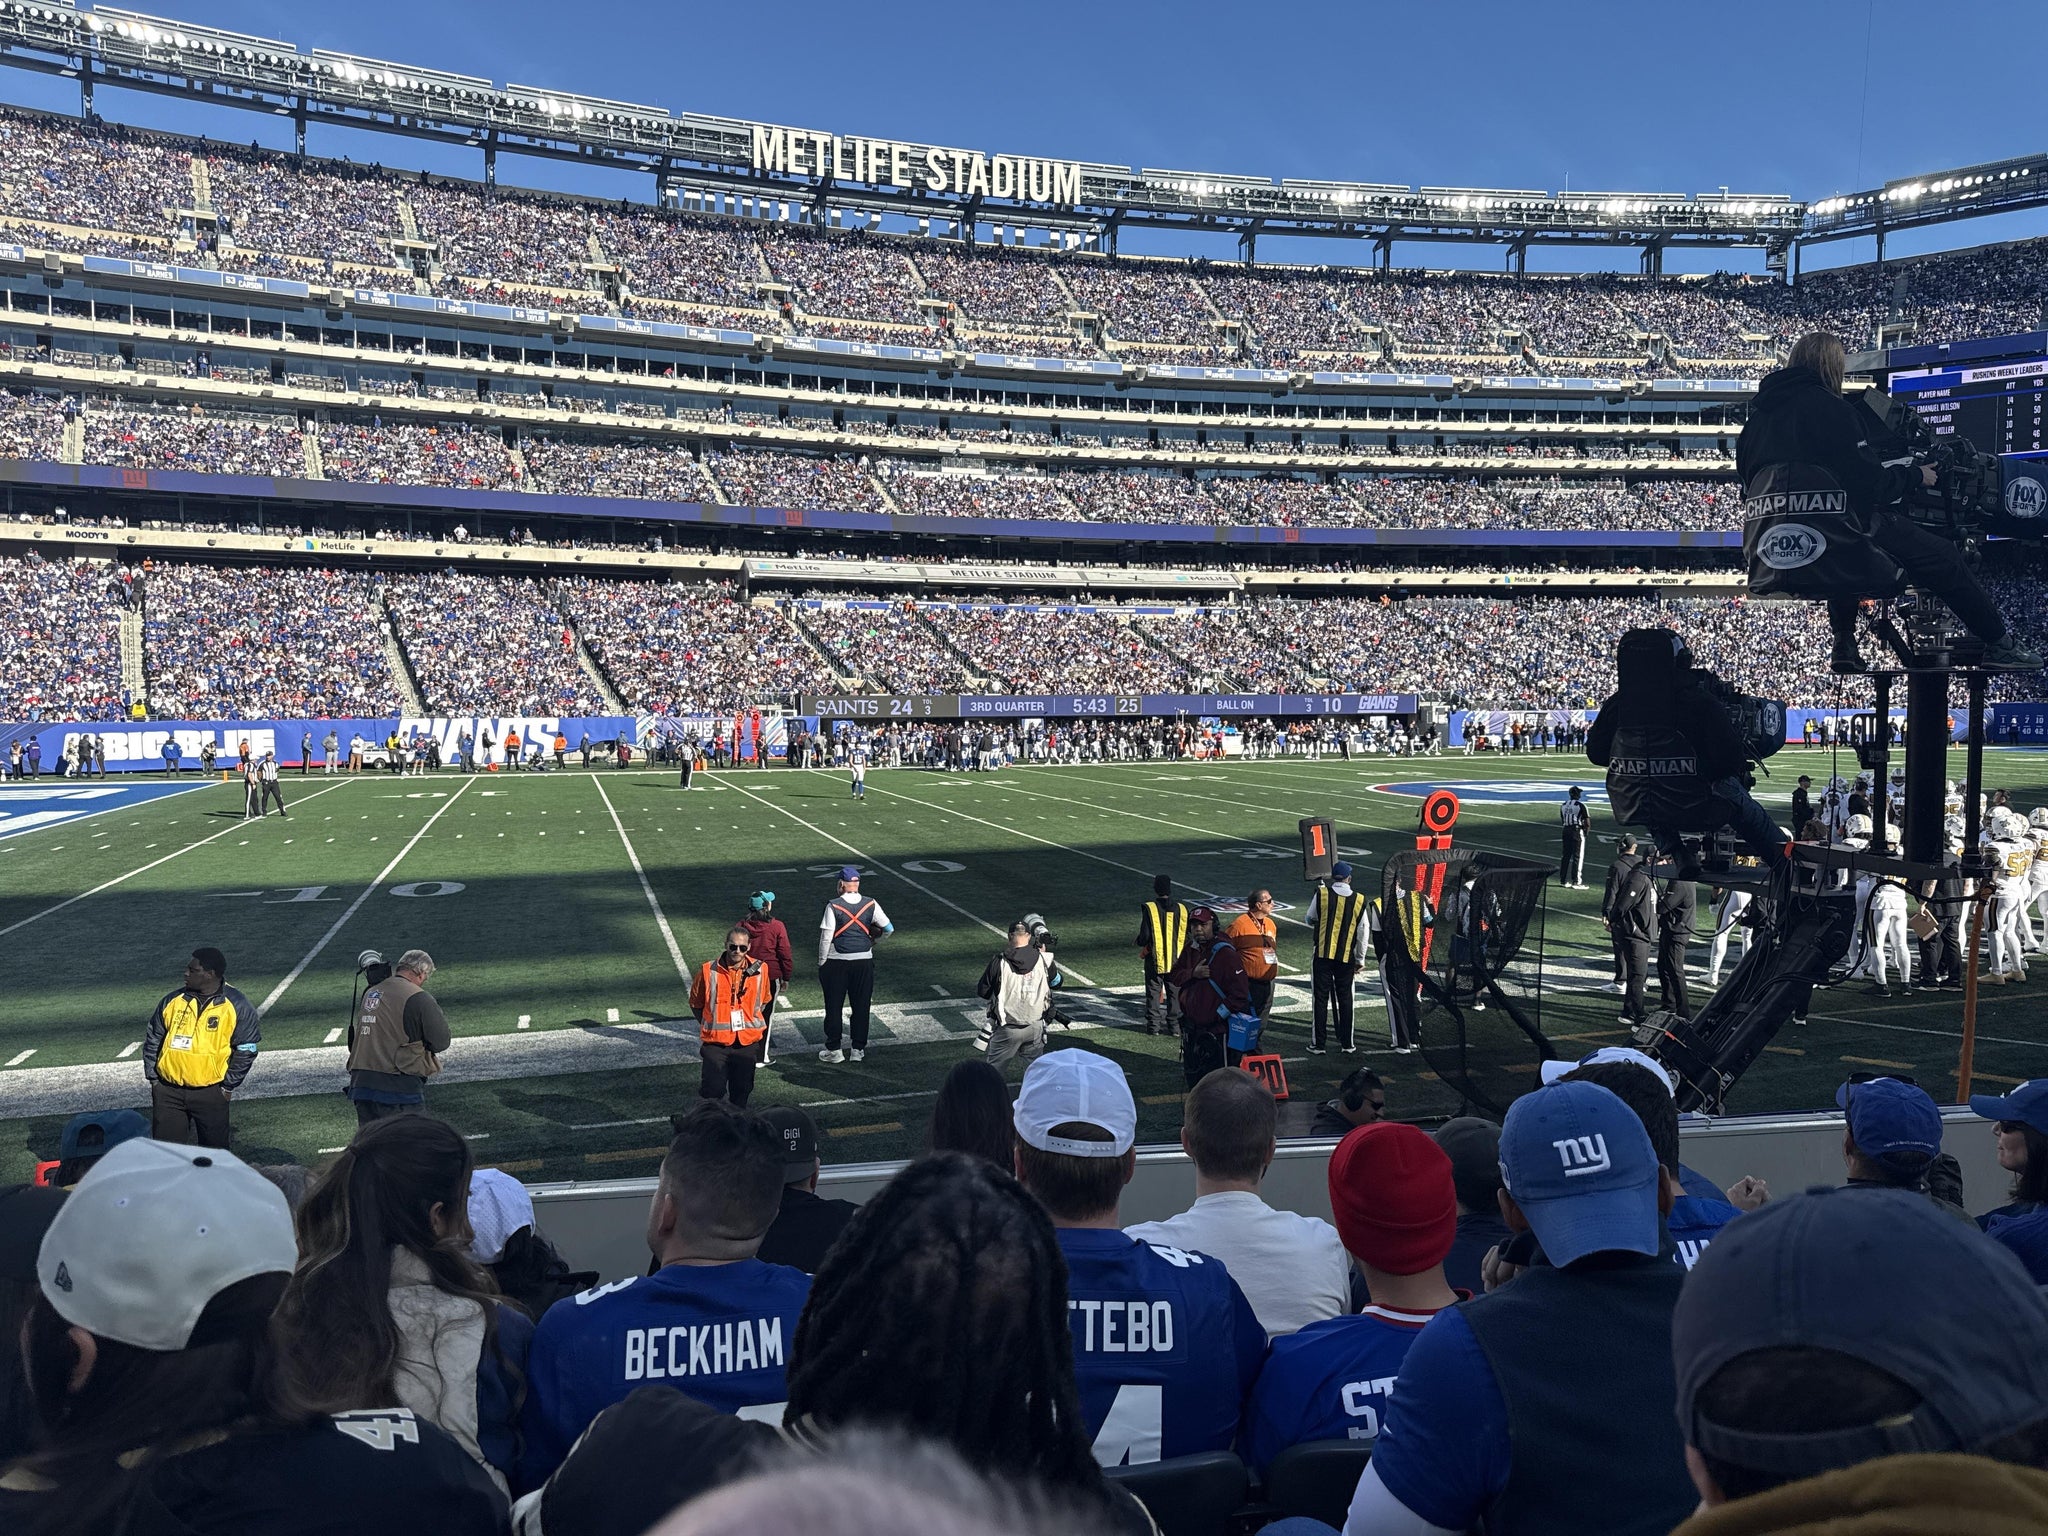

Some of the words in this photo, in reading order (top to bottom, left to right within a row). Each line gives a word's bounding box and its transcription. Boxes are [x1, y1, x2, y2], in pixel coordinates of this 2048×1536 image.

[752, 125, 912, 188] METLIFE
[926, 148, 1081, 205] STADIUM
[146, 269, 173, 280] BARNES
[225, 276, 236, 285] 53
[238, 280, 264, 290] CARSON
[1972, 371, 1997, 380] RUSHING
[1998, 367, 2019, 377] WEEKLY
[2019, 364, 2043, 375] LEADERS
[1918, 390, 1936, 399] PLAYER
[1936, 389, 1951, 397] NAME
[2006, 382, 2016, 390] ATT
[2033, 379, 2043, 387] YDS
[1917, 404, 1940, 414] EMANUEL
[1940, 402, 1960, 412] WILSON
[2007, 397, 2014, 405] 14
[1930, 414, 1952, 424] POLLARD
[2007, 408, 2013, 417] 11
[1936, 426, 1955, 435] MILLER
[2006, 420, 2013, 429] 10
[2005, 444, 2011, 452] 11
[2013, 484, 2038, 505] FOX
[1747, 492, 1844, 517] CHAPMAN
[65, 530, 109, 540] MOODY'S
[320, 541, 356, 551] MetLife
[1770, 535, 1803, 551] FOX
[775, 563, 821, 573] MetLife
[950, 569, 1000, 579] METLIFE
[1002, 570, 1057, 580] STADIUM
[1189, 574, 1231, 583] MetLife
[1650, 577, 1679, 585] verizon
[815, 700, 879, 715] SAINTS
[890, 700, 913, 715] 24
[924, 705, 931, 715] 3
[970, 701, 992, 712] 3RD
[994, 701, 1045, 713] QUARTER
[1072, 699, 1107, 713] 5:43
[1119, 699, 1138, 713] 25
[1216, 700, 1237, 710] BALL
[1239, 700, 1254, 710] ON
[1306, 704, 1312, 712] 3
[1323, 698, 1342, 712] 10
[1358, 695, 1399, 713] GIANTS
[99, 731, 171, 761] BIG
[173, 729, 275, 761] BLUE
[394, 718, 560, 765] GIANTS
[1610, 757, 1695, 776] CHAPMAN
[1310, 824, 1326, 857] 1
[784, 1128, 801, 1140] GIGI
[790, 1140, 797, 1151] 2
[625, 1317, 784, 1380] BECKHAM
